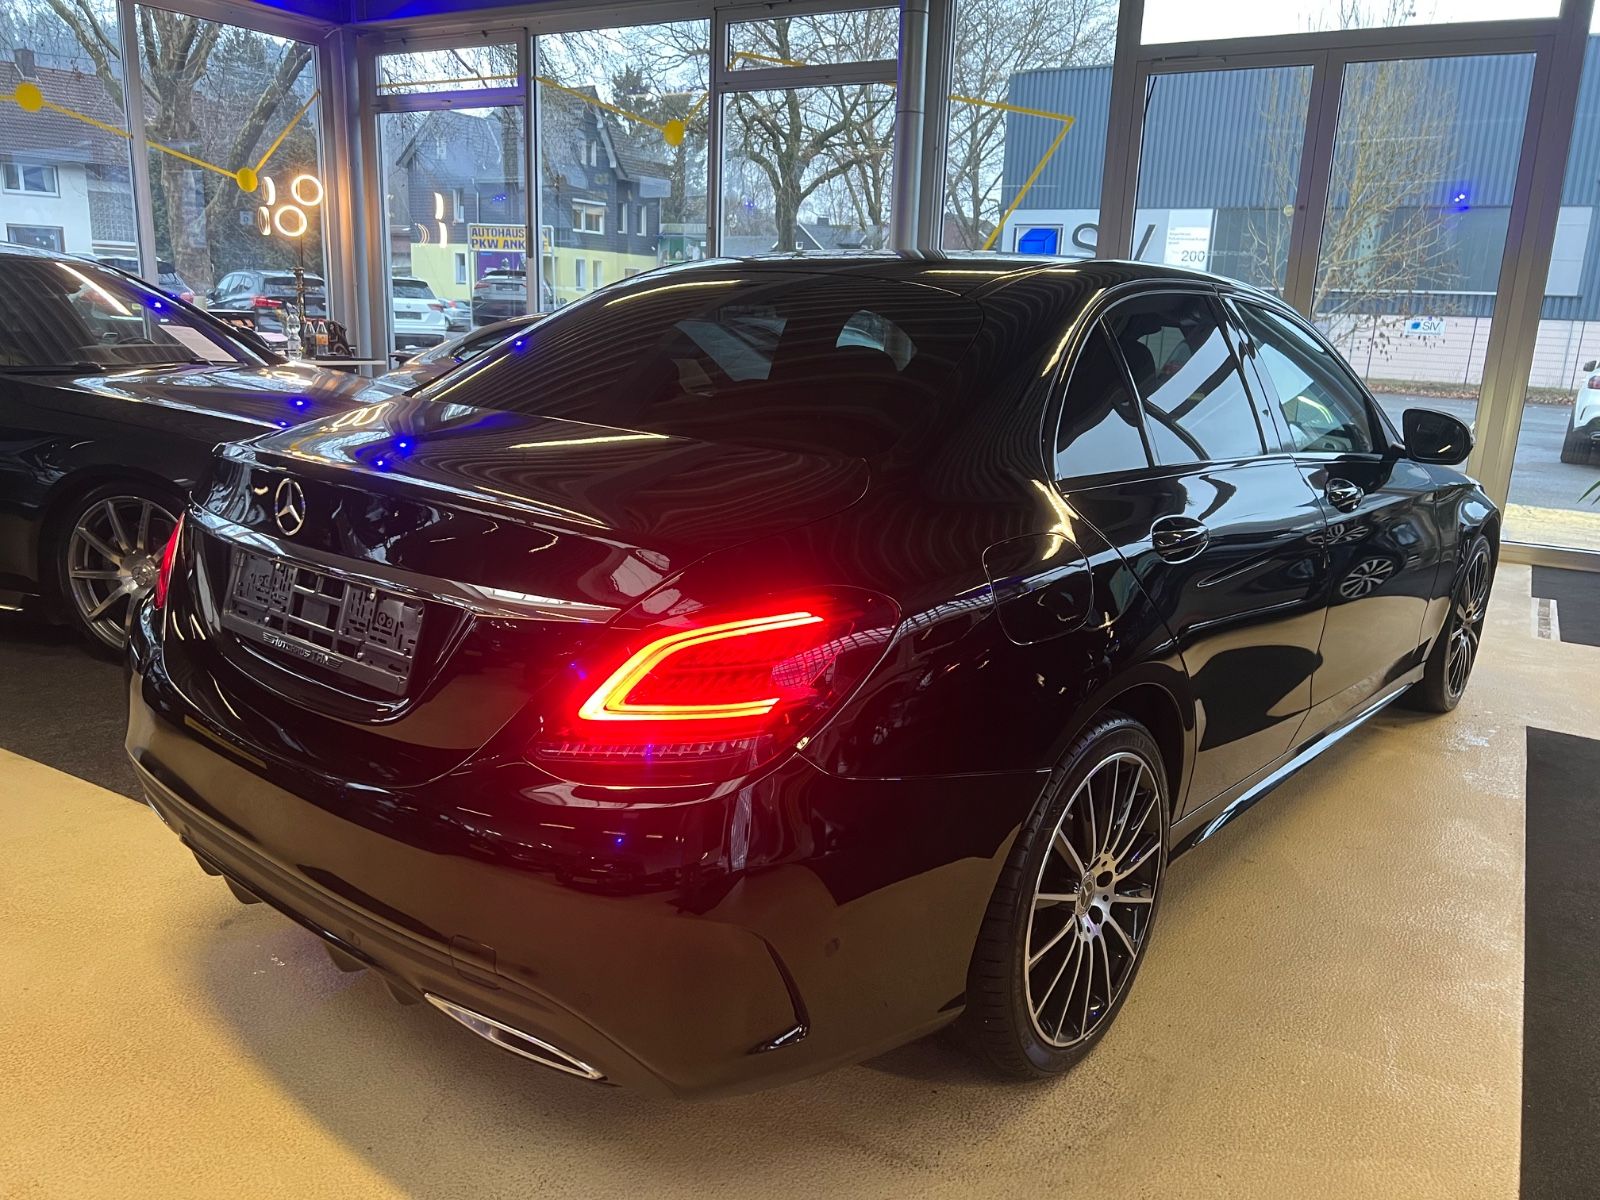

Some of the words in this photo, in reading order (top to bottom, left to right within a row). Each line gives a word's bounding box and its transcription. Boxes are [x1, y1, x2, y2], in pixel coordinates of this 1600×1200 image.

[471, 227, 525, 238] AUTOHAUS
[471, 238, 498, 249] PKW
[1181, 250, 1205, 262] 200
[1422, 321, 1440, 331] SIV
